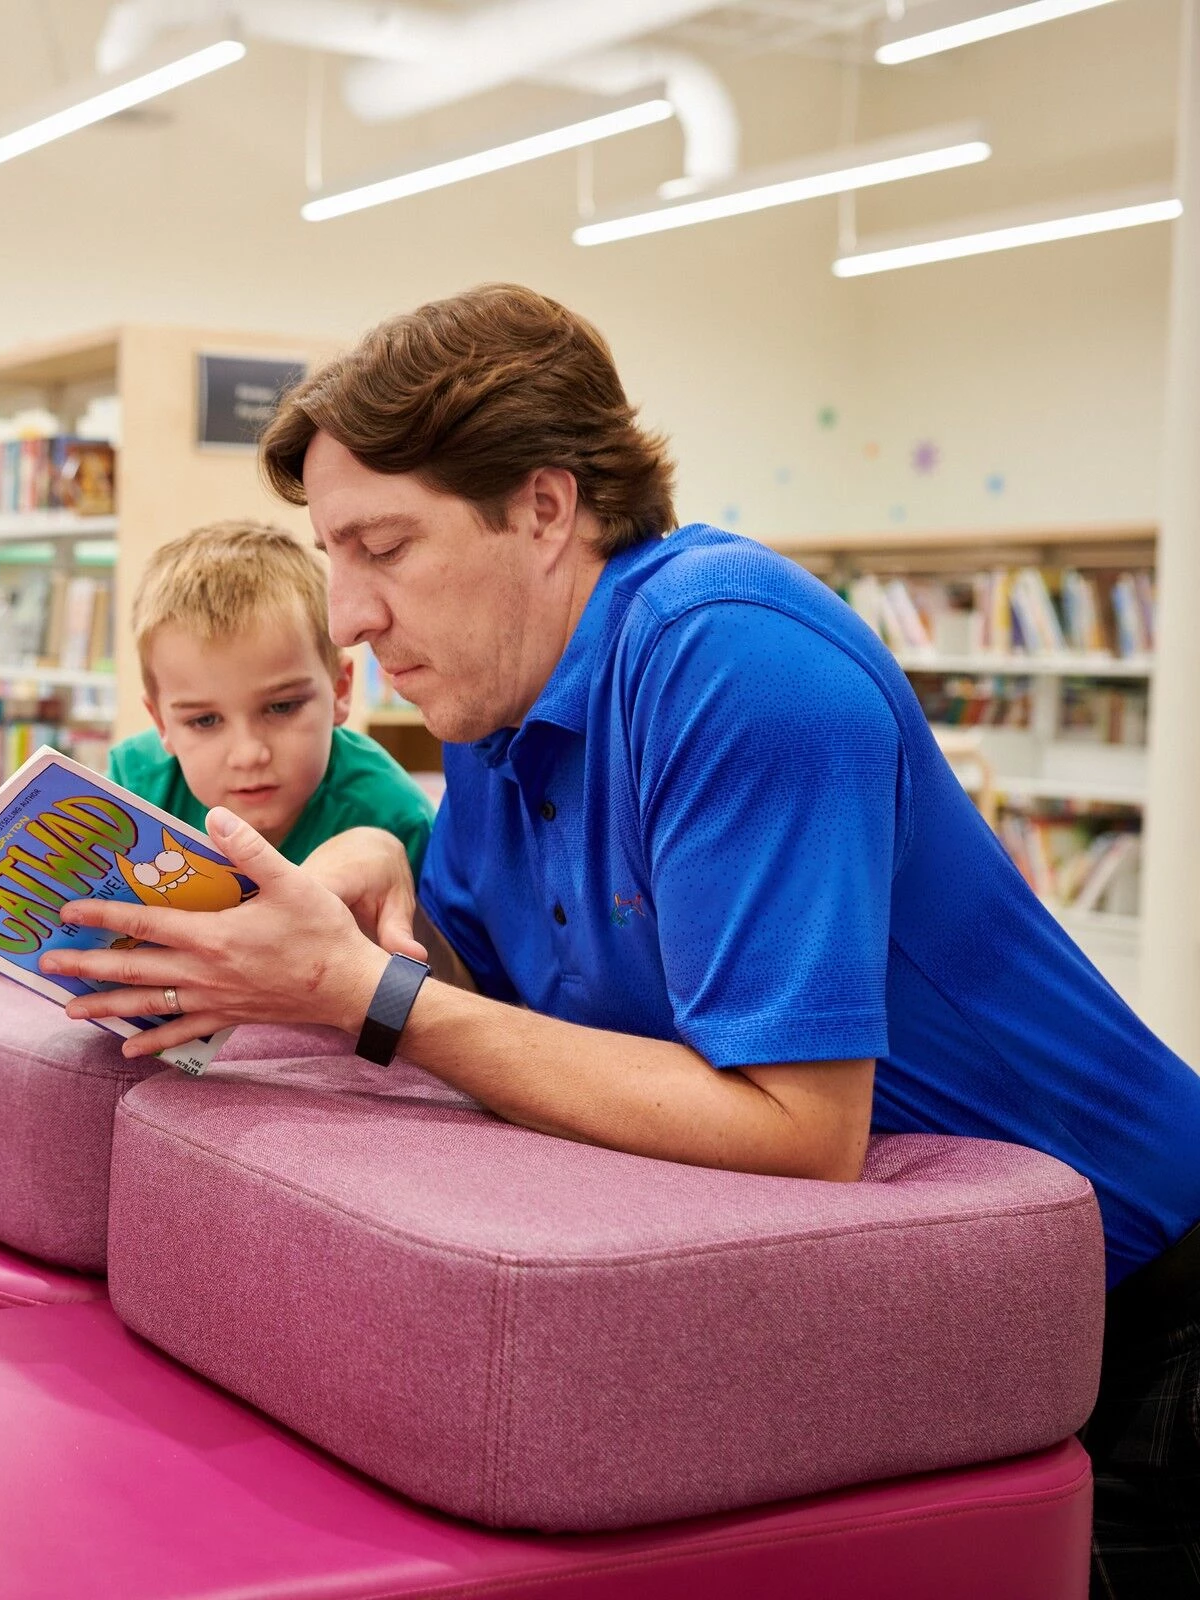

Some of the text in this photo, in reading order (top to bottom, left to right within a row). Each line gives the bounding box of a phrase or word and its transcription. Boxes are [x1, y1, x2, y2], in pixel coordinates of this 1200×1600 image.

[20, 788, 41, 807] AUTHOR
[91, 875, 125, 899] IVE!
[188, 1057, 203, 1069] 2021
